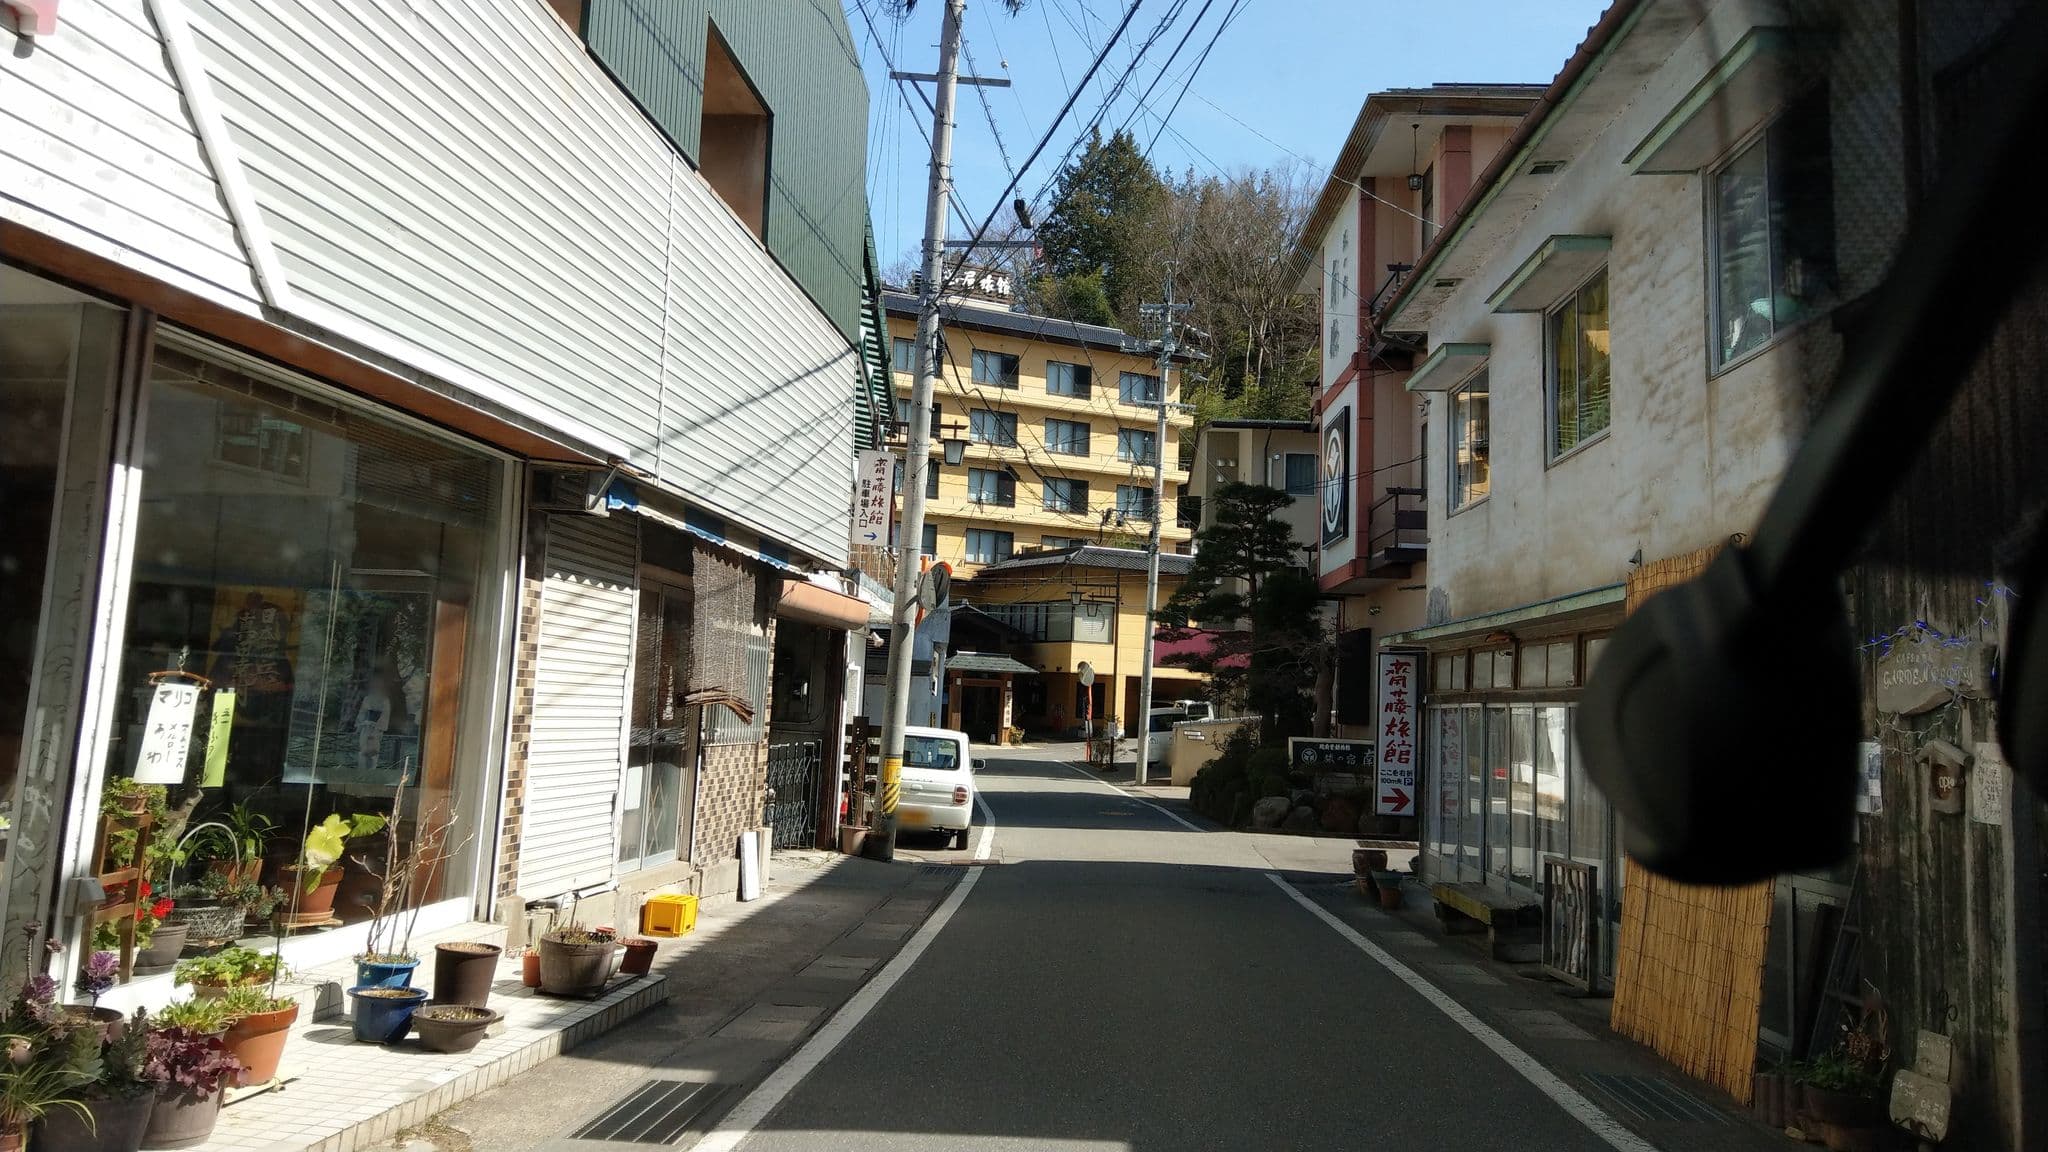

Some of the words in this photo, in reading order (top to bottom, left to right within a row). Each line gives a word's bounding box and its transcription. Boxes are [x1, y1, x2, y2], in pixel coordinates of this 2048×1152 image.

[858, 479, 871, 529] 駐車場入口
